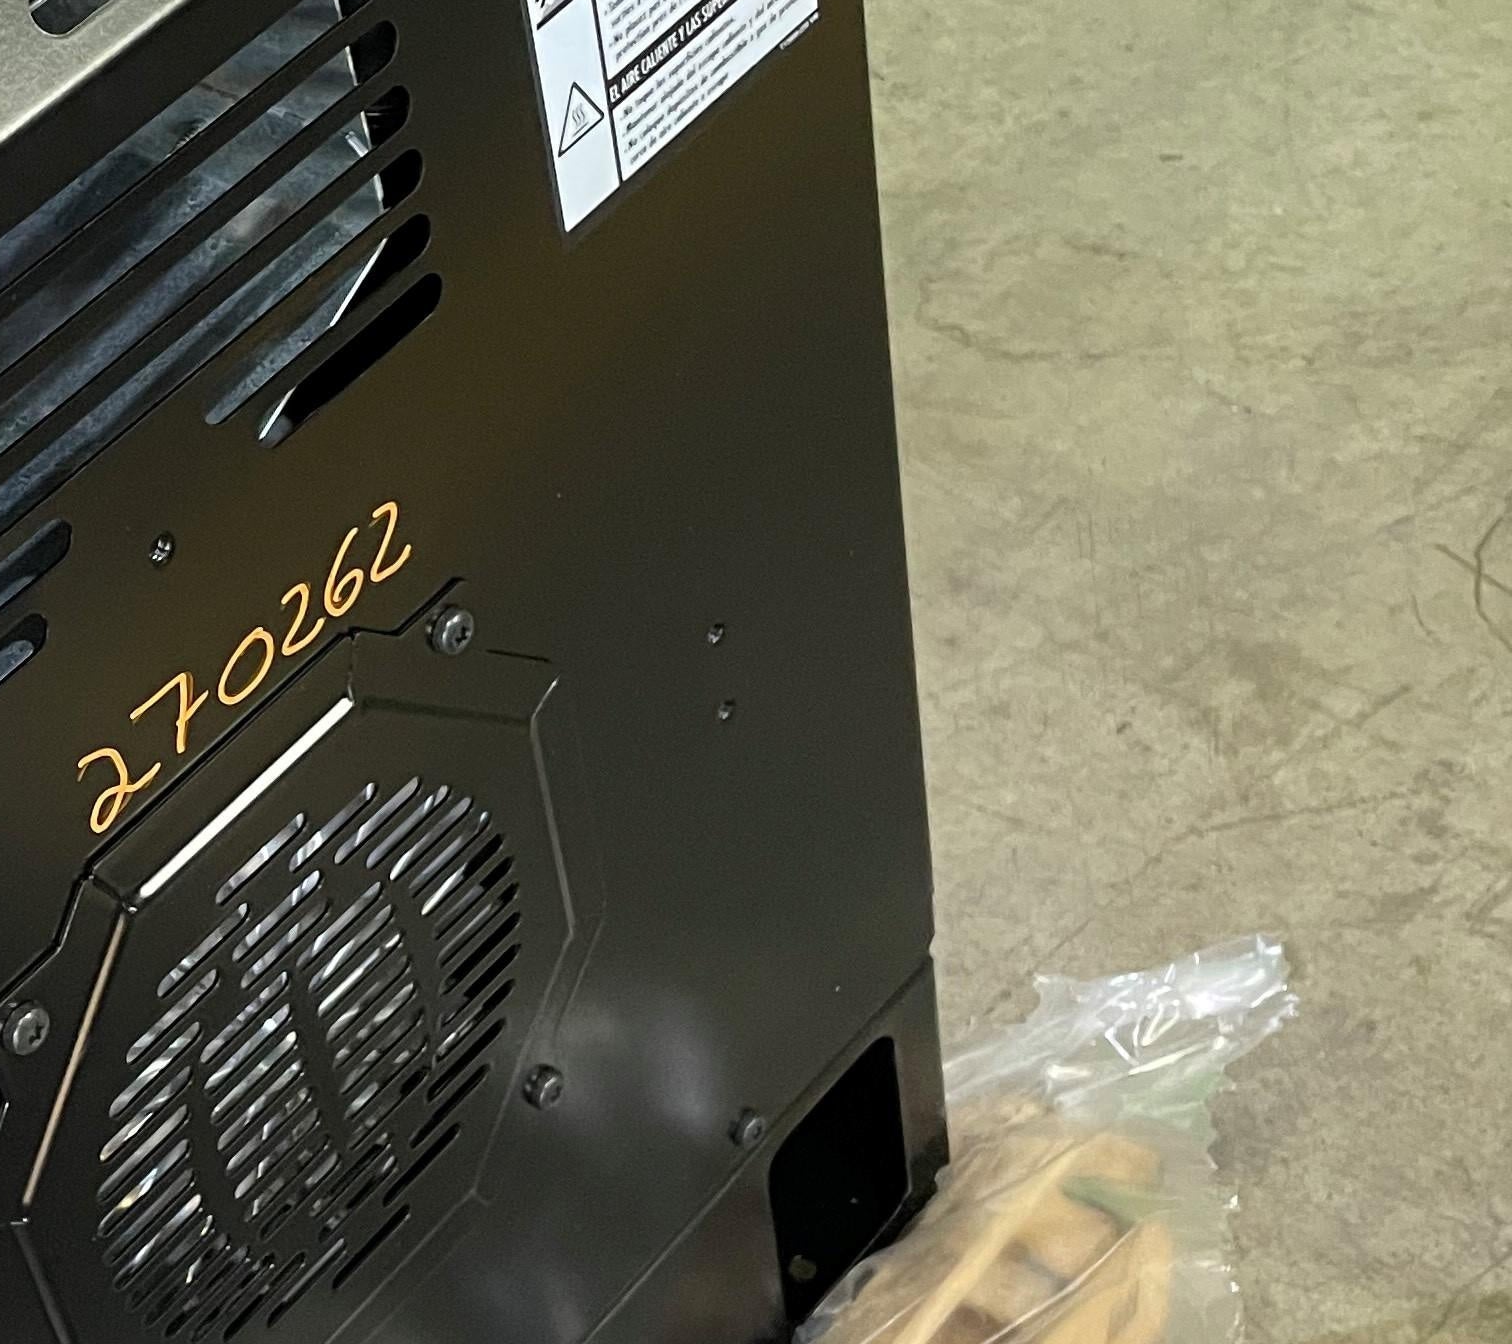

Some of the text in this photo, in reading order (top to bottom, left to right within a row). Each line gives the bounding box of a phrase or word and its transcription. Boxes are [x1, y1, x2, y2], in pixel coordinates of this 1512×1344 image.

[609, 81, 620, 103] EL
[620, 63, 640, 94] AIRE
[640, 30, 677, 76] CALIENTE
[685, 9, 701, 37] LAS
[76, 501, 413, 835] 270262
